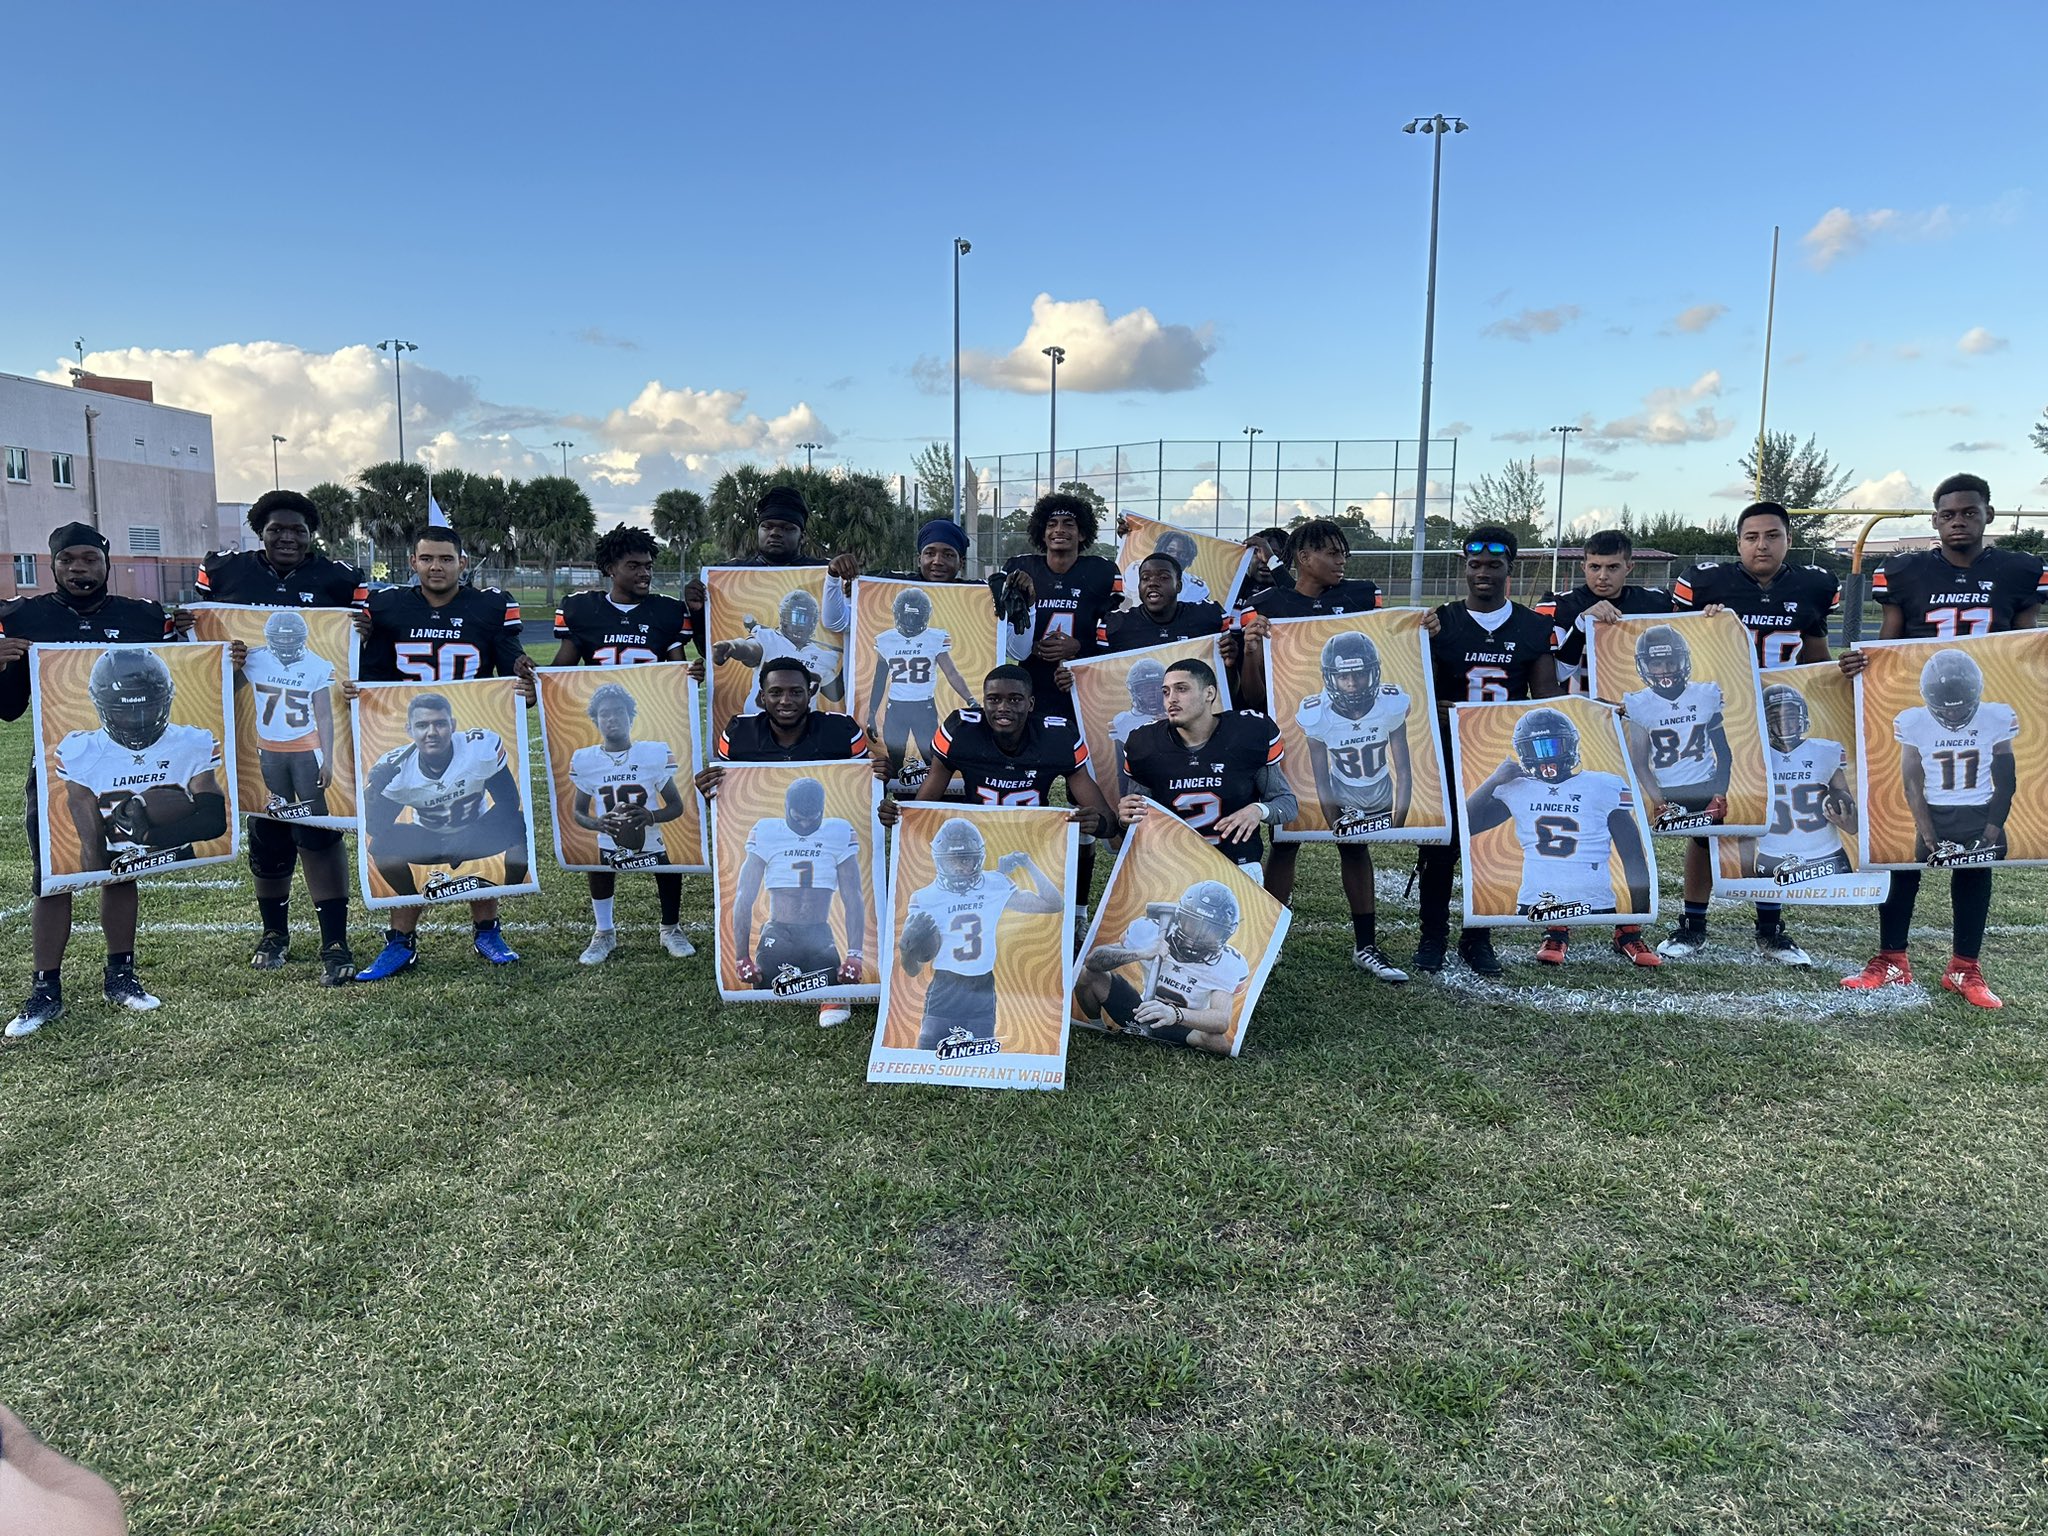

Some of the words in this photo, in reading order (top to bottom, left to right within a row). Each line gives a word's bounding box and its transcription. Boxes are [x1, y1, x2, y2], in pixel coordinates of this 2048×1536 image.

[1037, 599, 1078, 609] LANCERS
[1929, 592, 1990, 604] LANCERS
[1741, 614, 1793, 626] ANCERS
[1925, 607, 1993, 639] 11
[410, 628, 461, 639] LANCERS
[603, 634, 647, 645] LANCERS
[394, 642, 480, 682] 50
[1464, 652, 1513, 663] LANCERS
[888, 656, 932, 684] 28
[267, 675, 302, 687] LANCERS
[1466, 666, 1509, 702] 6
[255, 682, 311, 728] 75
[1660, 714, 1697, 726] LANCERS
[1340, 734, 1377, 747] LANCERS
[1648, 722, 1707, 769] 84
[1935, 739, 1976, 747] LANCERS
[1328, 740, 1388, 779] 80
[1772, 771, 1812, 781] ANCERS
[1932, 749, 1979, 790] 11
[113, 772, 167, 787] LANCERS
[603, 774, 637, 783] LANCERS
[903, 773, 929, 786] LANC
[985, 776, 1034, 789] LANCERS
[1169, 777, 1222, 790] LANCERS
[424, 789, 465, 807] LANCERS
[271, 806, 311, 819] LANCERS
[1529, 803, 1580, 813] LANCERS
[1769, 782, 1830, 836] 59
[1172, 791, 1222, 845] 2
[1657, 816, 1711, 832] LANCERS
[1337, 817, 1390, 837] LANCERS
[1534, 815, 1580, 859] 6
[784, 849, 821, 857] LANCERS
[1933, 851, 1995, 867] LANCERS
[116, 853, 176, 876] LANCERS
[614, 857, 658, 871] LANCERS
[791, 860, 814, 888] 1
[1779, 863, 1834, 886] LANCERS
[428, 879, 478, 900] LANCERS
[1750, 889, 1784, 899] RUDY
[1786, 887, 1828, 899] NUÑEZ
[947, 902, 984, 914] LANCERS
[1533, 904, 1591, 922] LANCERS
[949, 913, 982, 962] 3
[777, 975, 828, 996] LANCERS
[1158, 974, 1193, 994] ANCERS
[941, 1042, 1000, 1060] LANCERS
[870, 1061, 885, 1073] #3
[886, 1062, 936, 1075] FEGENS
[937, 1065, 1016, 1080] SOUFFRANT
